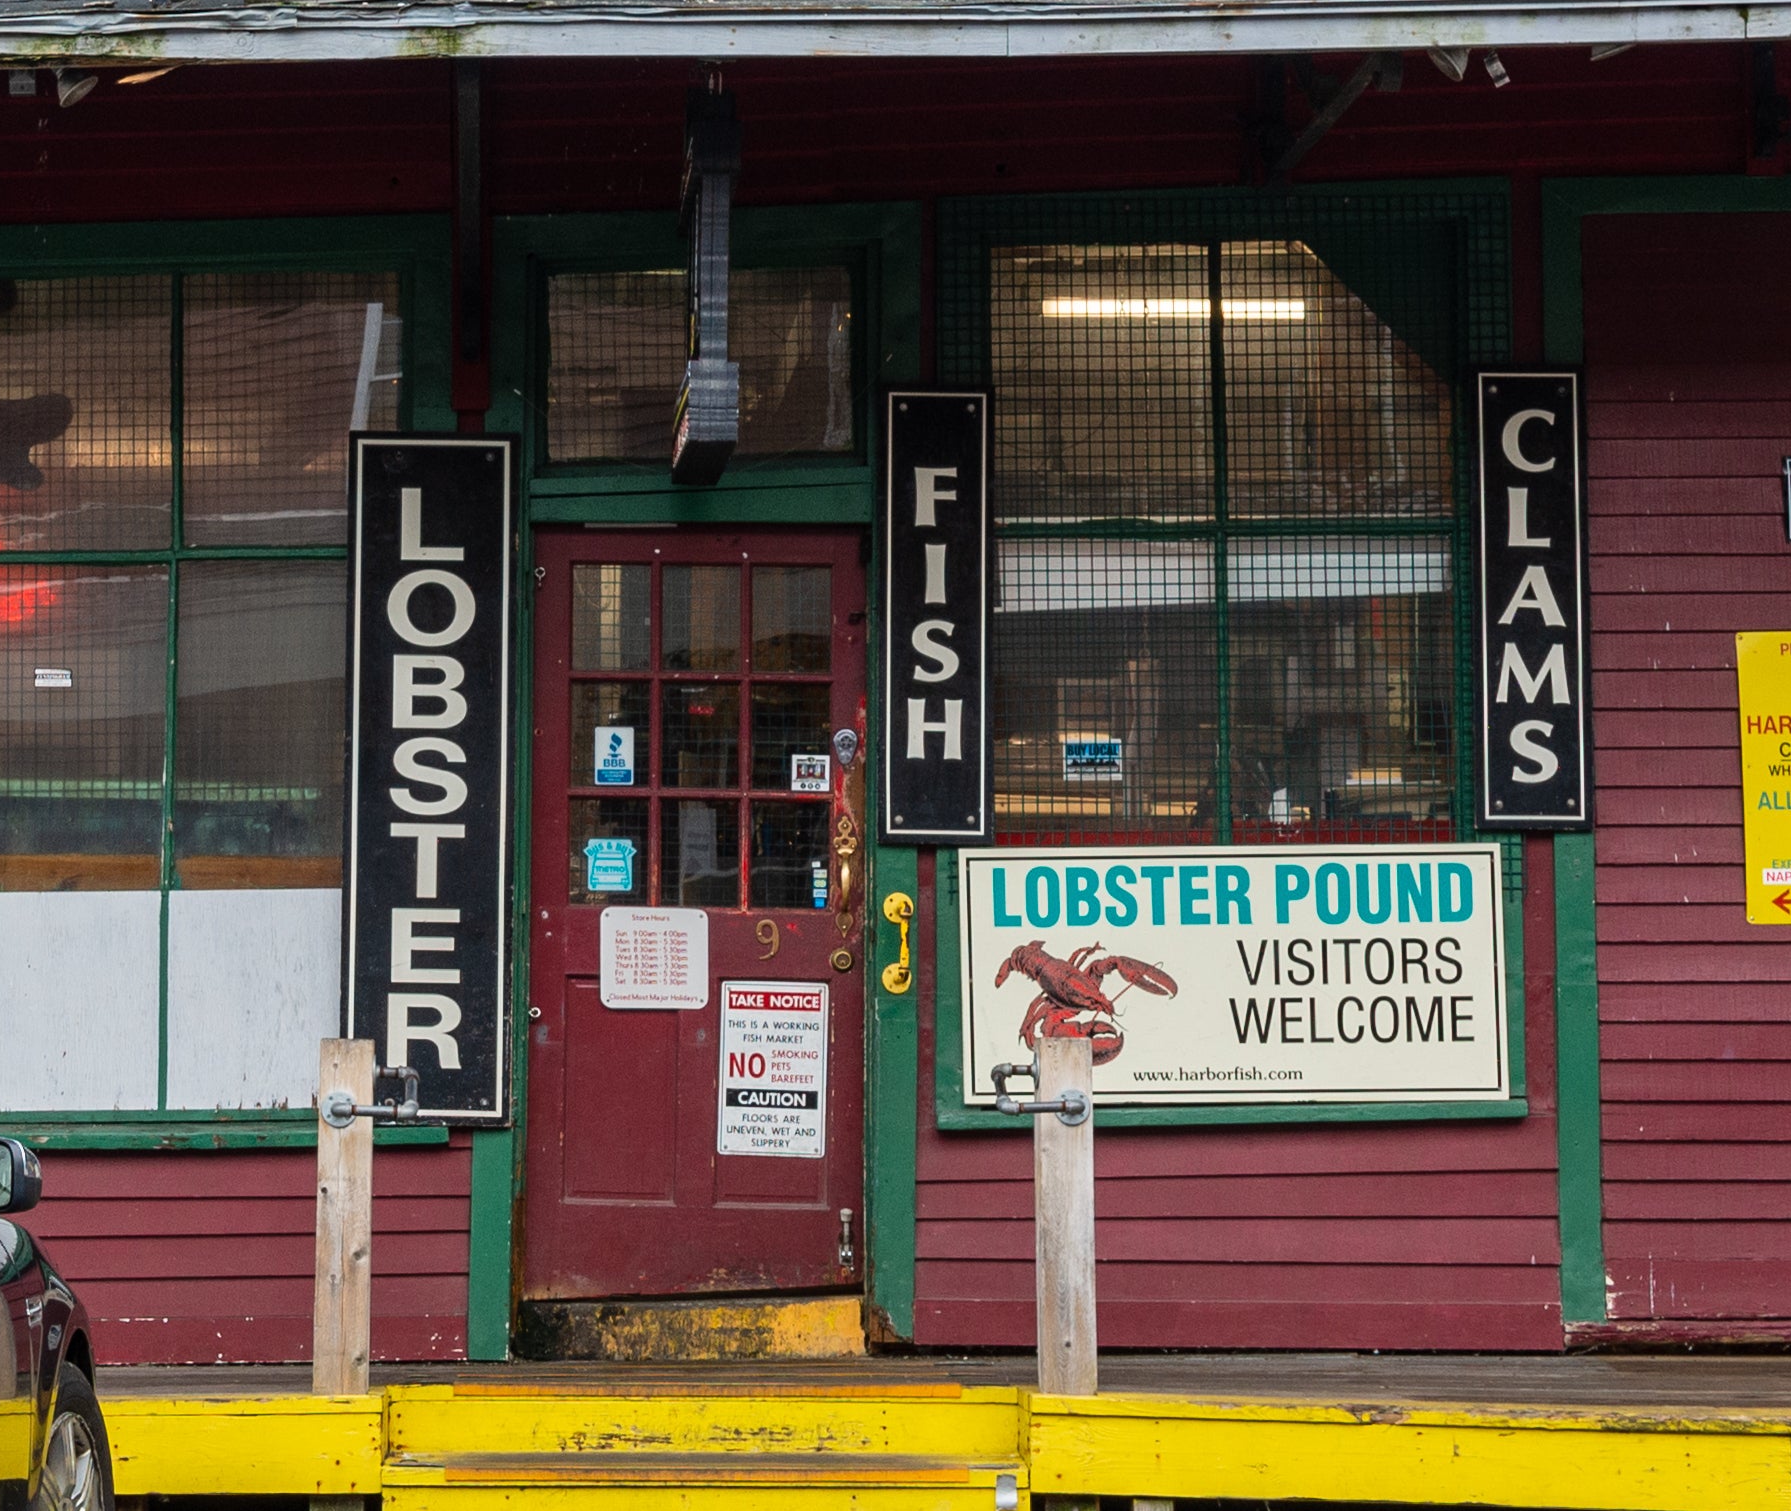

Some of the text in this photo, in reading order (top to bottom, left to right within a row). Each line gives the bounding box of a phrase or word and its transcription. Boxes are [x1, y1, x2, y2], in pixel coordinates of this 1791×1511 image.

[1495, 408, 1572, 785] CLAMS
[906, 467, 964, 761] FISH
[603, 759, 626, 767] BBB
[386, 487, 477, 1069] LOBSTER
[992, 861, 1474, 929] LOBSTER POUND
[755, 919, 780, 961] 9
[1236, 937, 1462, 986] VISITORS
[730, 994, 820, 1008] TAKE NOTICE
[728, 1020, 819, 1031] THIS IS A WORKING
[1228, 996, 1475, 1045] WELCOME
[743, 1034, 803, 1044] FISH MARKET
[771, 1050, 818, 1059] SMOKING
[729, 1052, 766, 1078] NO
[771, 1062, 791, 1071] PETS
[771, 1074, 814, 1083] BAREFEET
[1132, 1066, 1304, 1084] www.harborfish.com
[738, 1091, 806, 1107] CAUTION
[742, 1113, 800, 1124] FLOORS ARE
[726, 1125, 816, 1136] UNEVEN, WET AND
[751, 1138, 790, 1147] SLIPPERY
